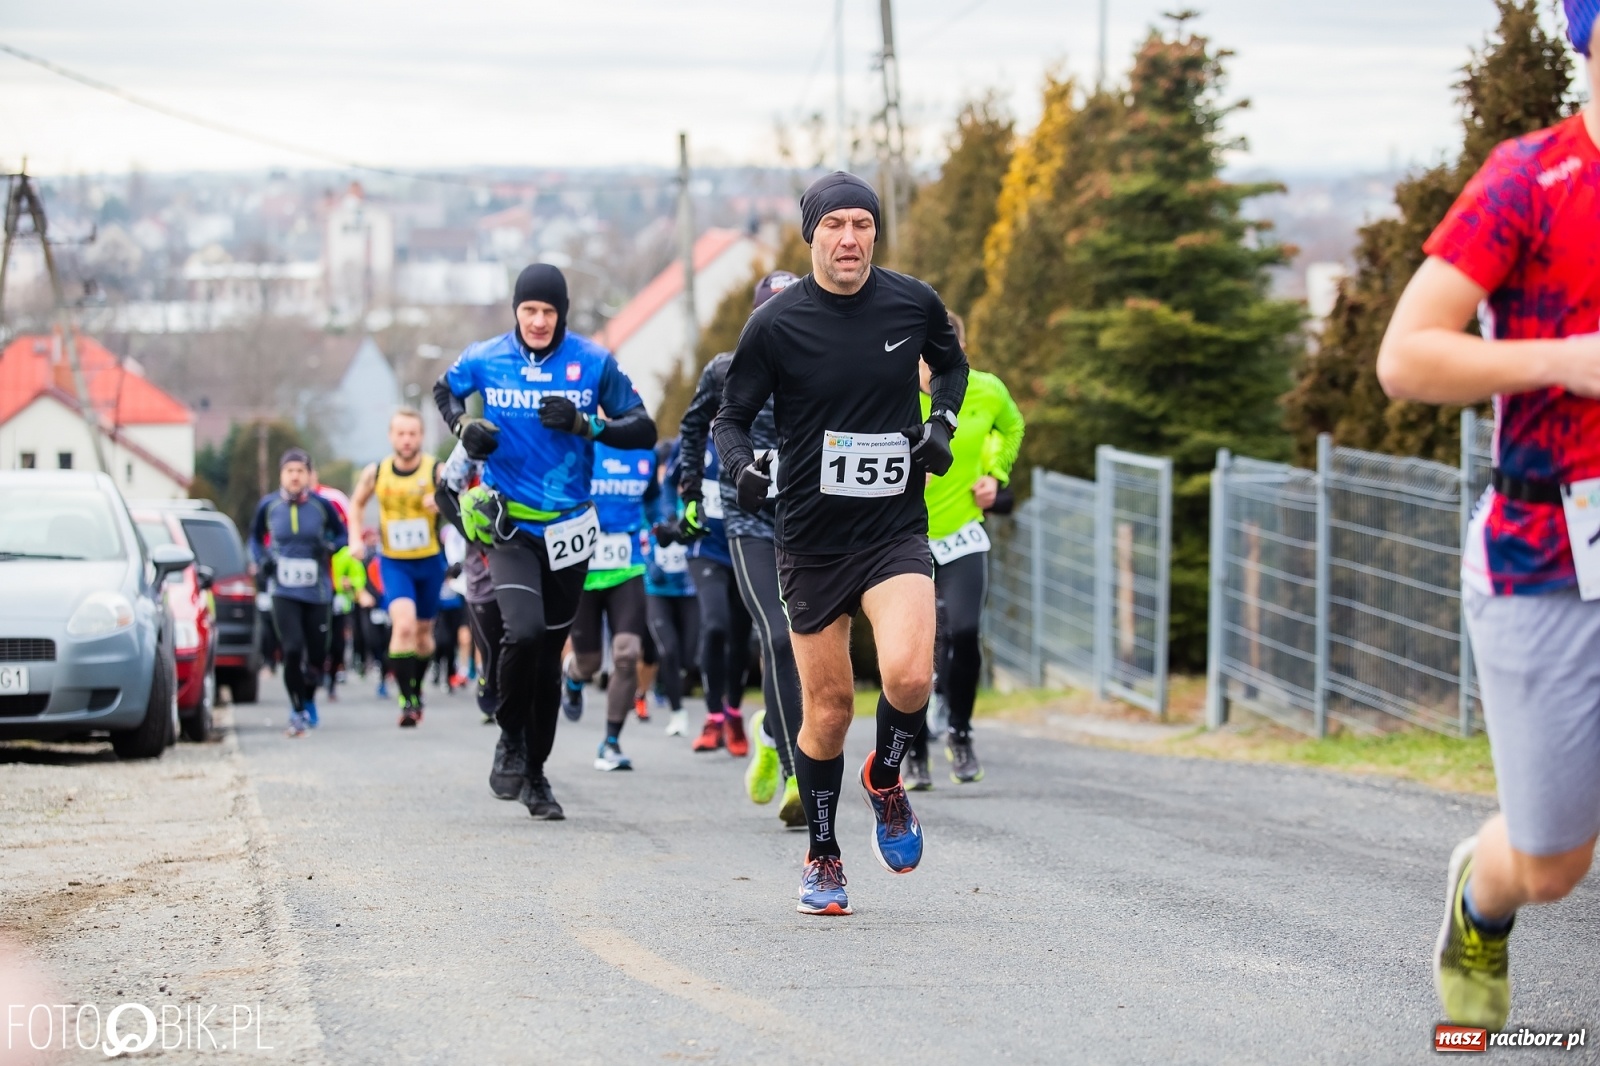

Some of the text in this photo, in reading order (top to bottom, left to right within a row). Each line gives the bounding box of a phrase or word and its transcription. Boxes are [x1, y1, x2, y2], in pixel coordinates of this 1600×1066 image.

[485, 387, 593, 409] RUNNRS
[829, 455, 905, 485] 155
[552, 526, 597, 561] 202
[937, 529, 982, 556] 340
[883, 725, 914, 768] Kalenji
[811, 789, 834, 842] Kalenji
